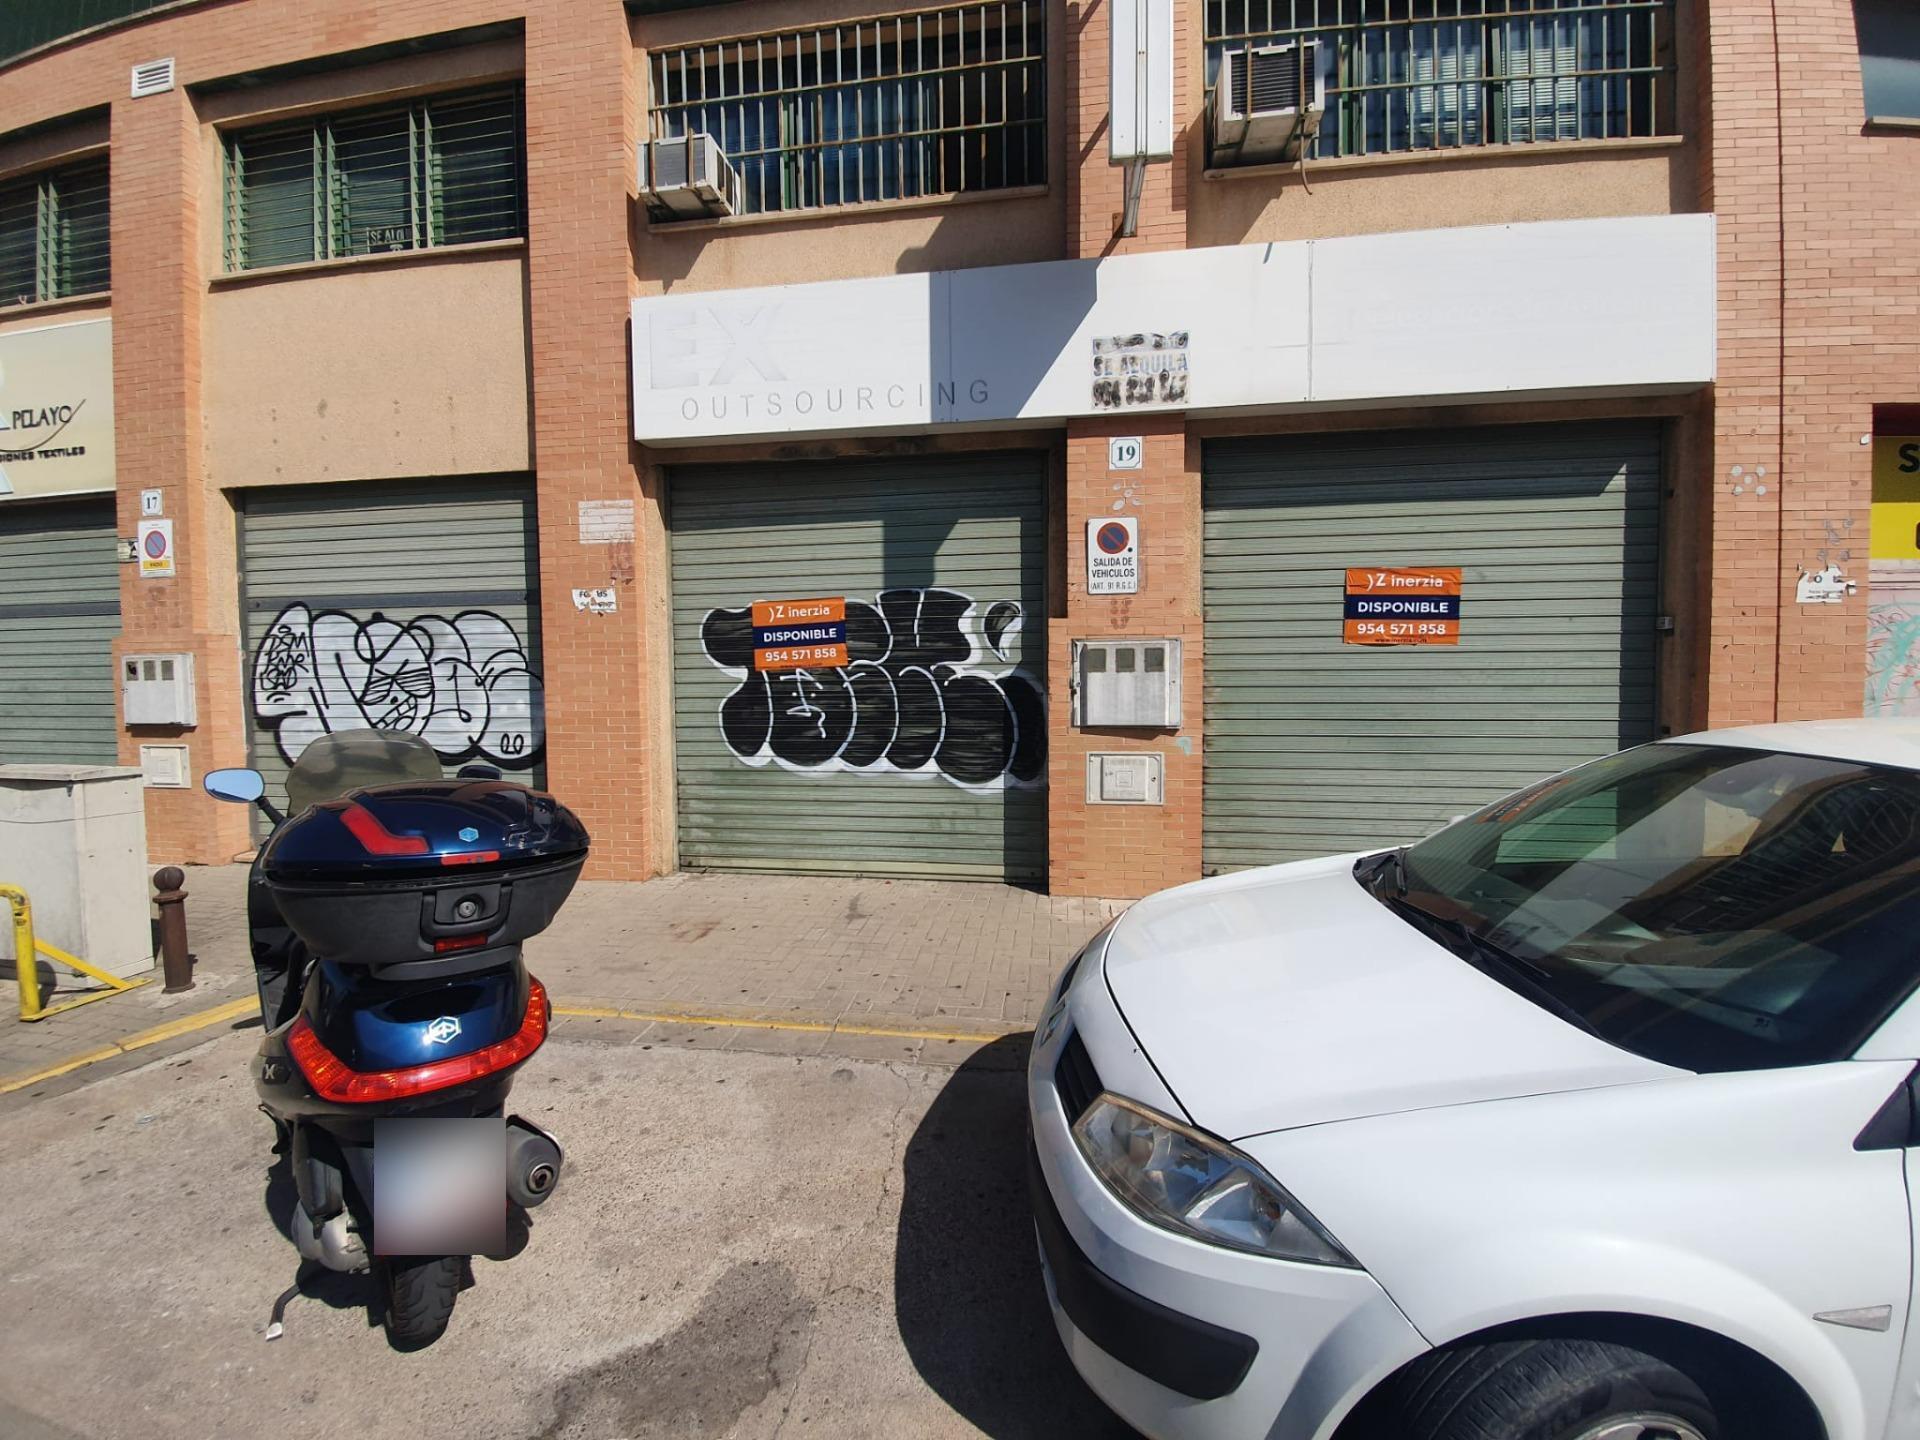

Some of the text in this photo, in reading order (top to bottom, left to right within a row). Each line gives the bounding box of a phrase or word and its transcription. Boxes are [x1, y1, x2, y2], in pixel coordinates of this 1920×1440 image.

[649, 303, 788, 390] EX
[681, 379, 989, 421] OUTSOURCING
[12, 405, 72, 429] PELAYO
[37, 446, 86, 459] TEXTILES
[1117, 445, 1136, 461] 19
[146, 496, 158, 510] 17
[1093, 557, 1133, 567] SALIDA DE
[1091, 568, 1135, 578] VEHICULOS
[1391, 575, 1443, 587] inerzia
[788, 604, 830, 617] inerzia
[1357, 601, 1449, 613] DISPONIBLE
[763, 628, 837, 642] DISPONIBLE
[1357, 623, 1446, 634] 954 571 858
[765, 648, 837, 662] 954 571 858
